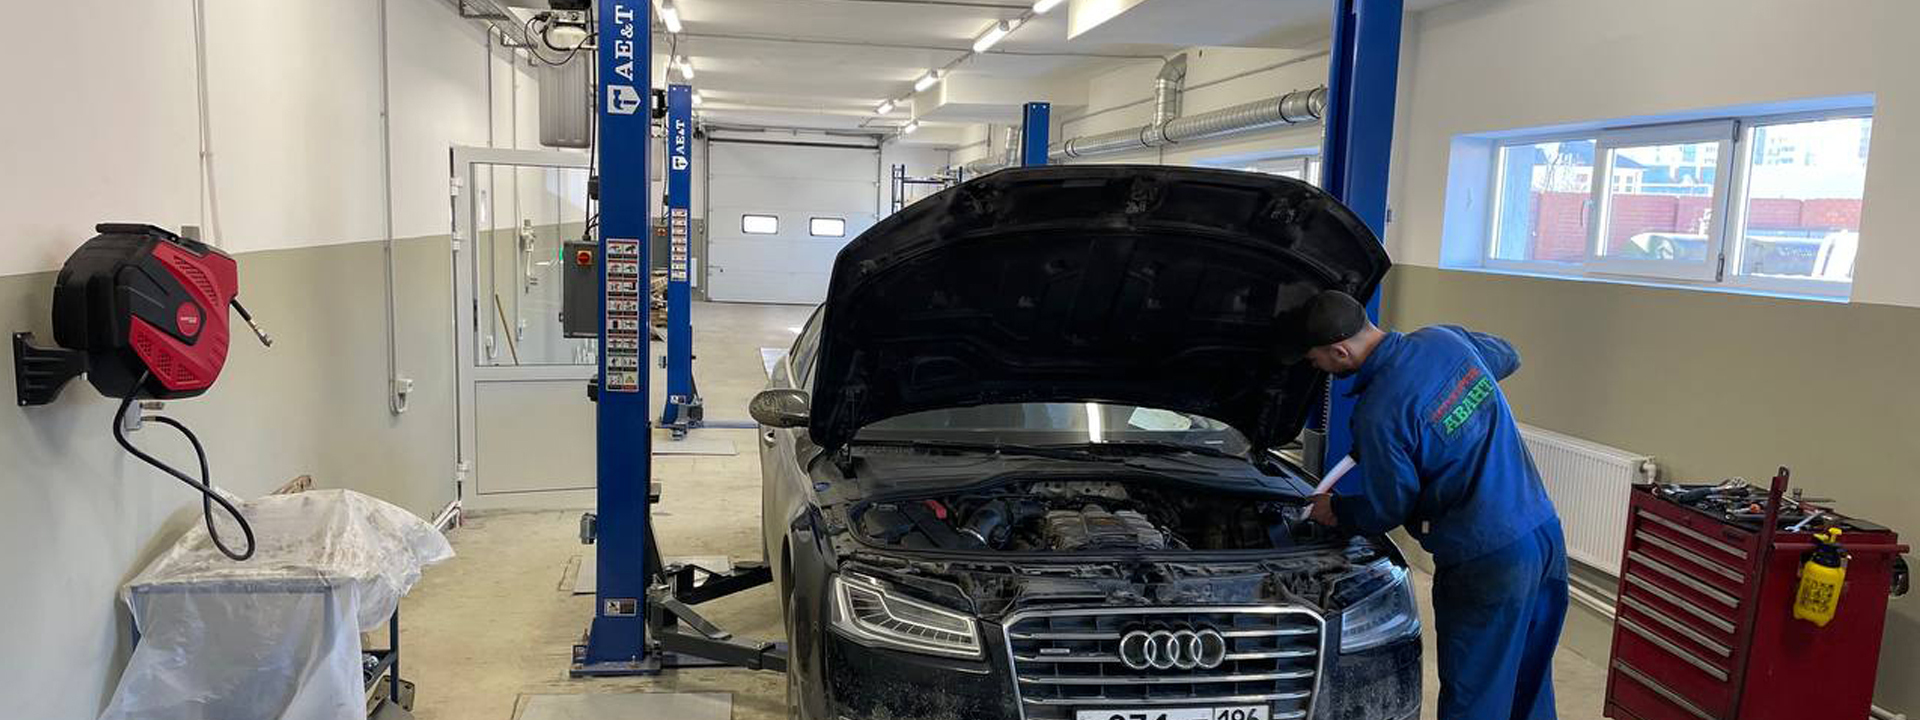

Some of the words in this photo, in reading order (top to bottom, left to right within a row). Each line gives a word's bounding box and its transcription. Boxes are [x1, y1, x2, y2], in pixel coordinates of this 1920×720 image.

[615, 5, 634, 81] AE&T
[675, 119, 686, 155] AE&T
[1443, 376, 1494, 435] АВАНТ
